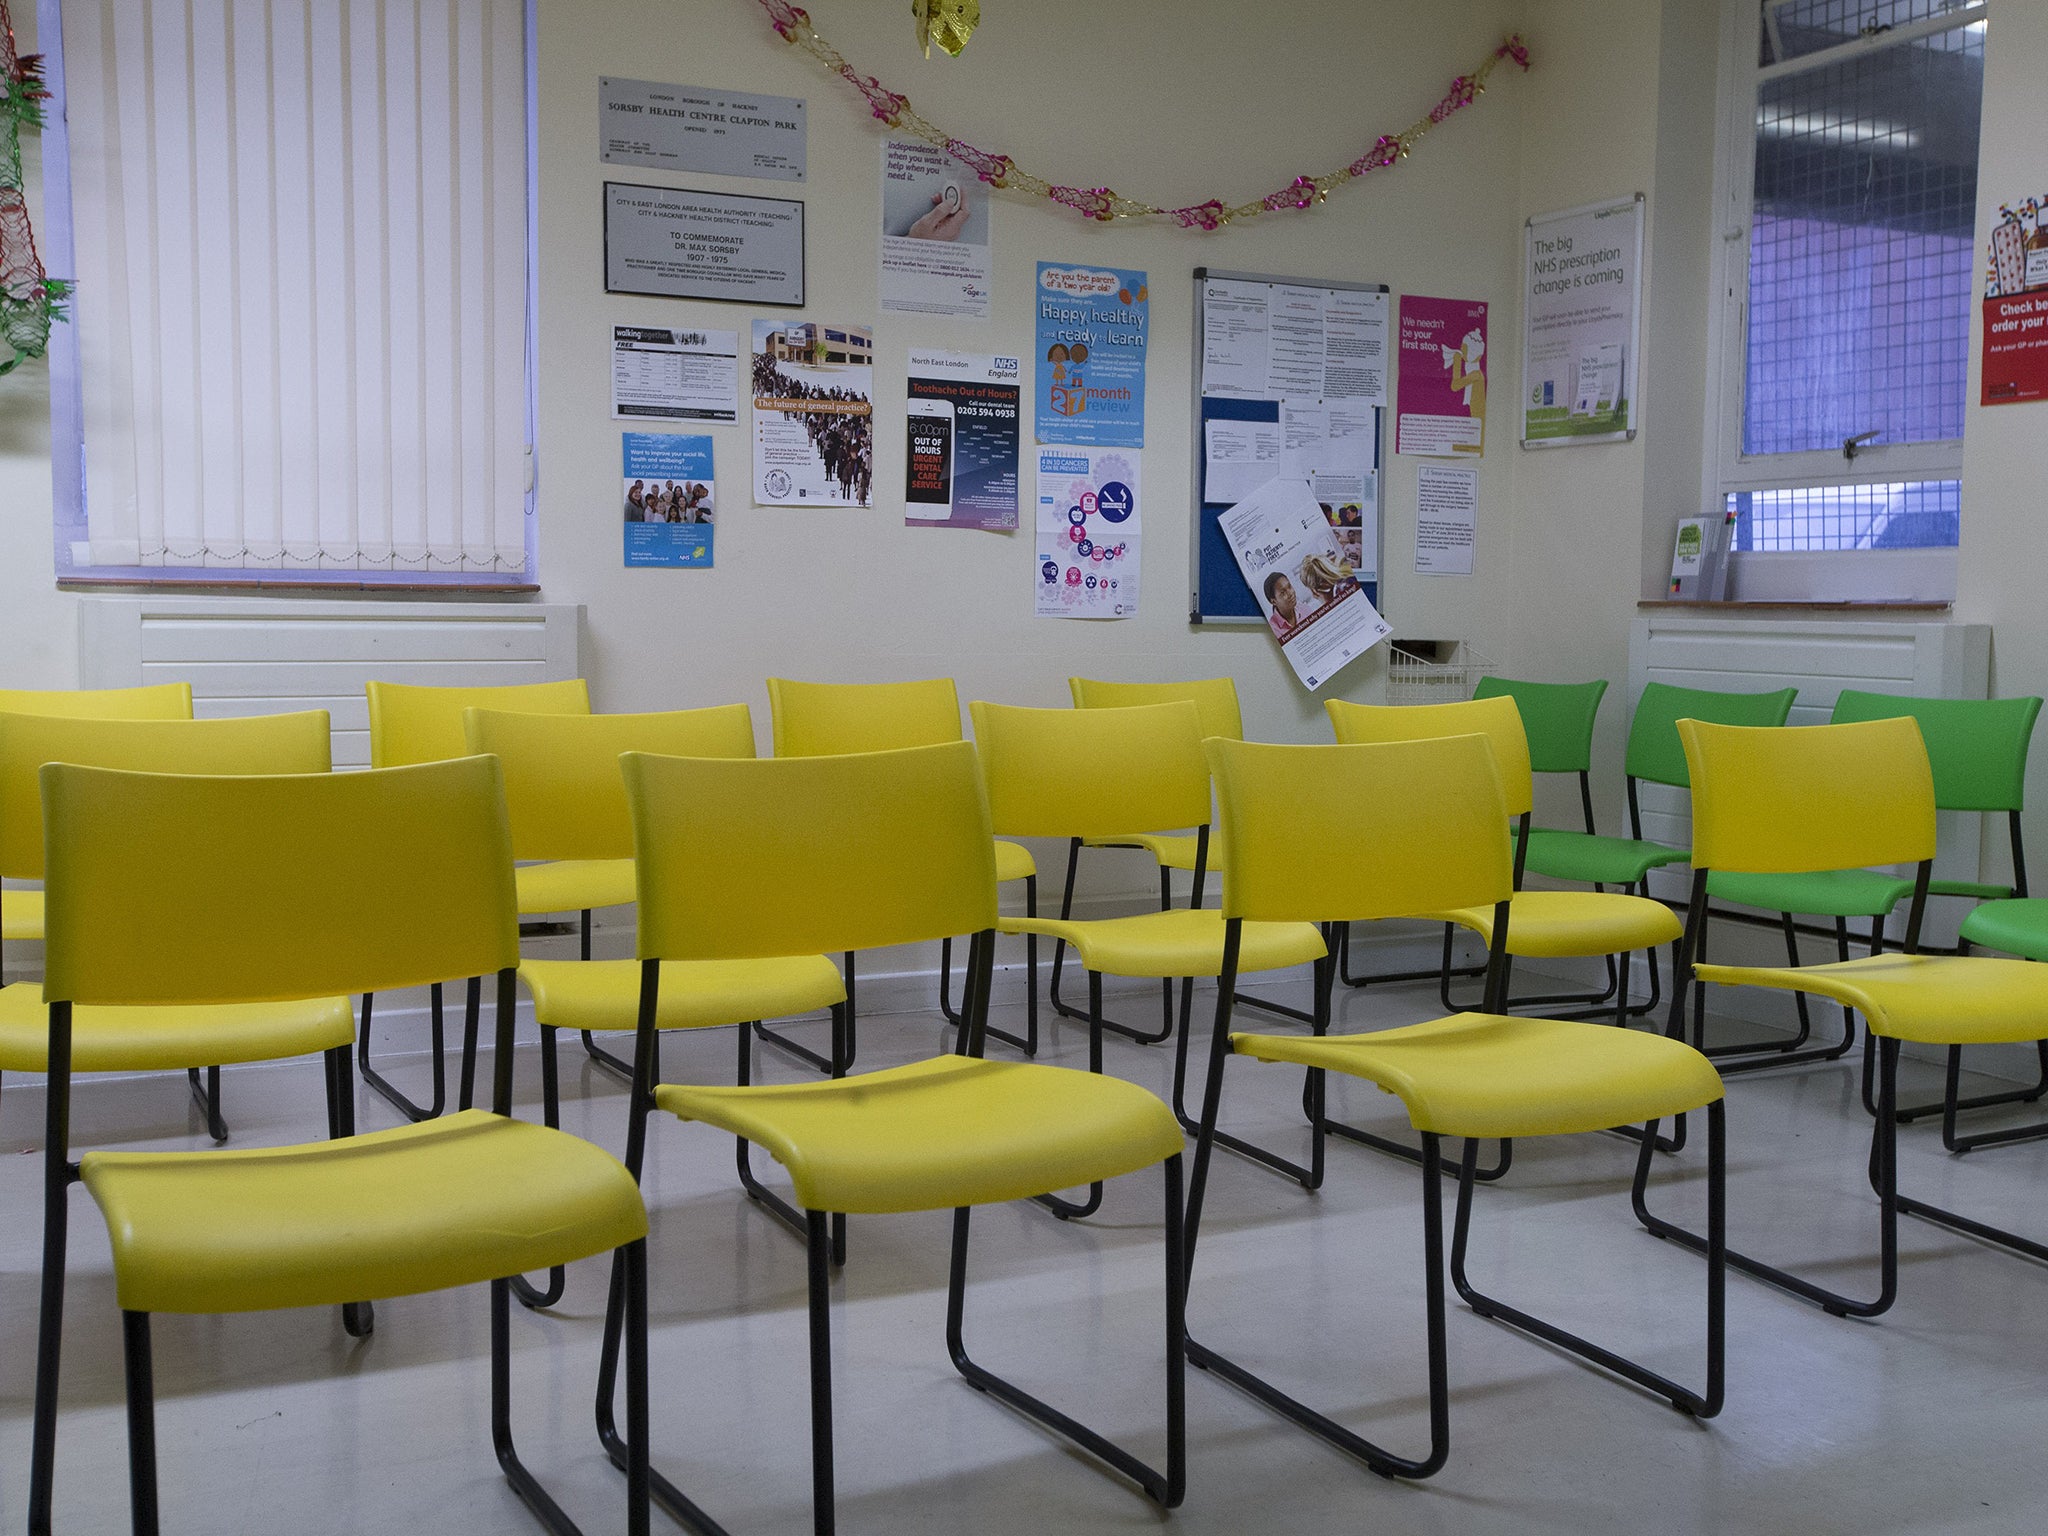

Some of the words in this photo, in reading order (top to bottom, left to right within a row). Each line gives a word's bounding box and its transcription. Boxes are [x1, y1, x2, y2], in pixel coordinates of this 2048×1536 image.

[649, 94, 674, 102] LONDON
[683, 98, 710, 106] BOROUGH
[732, 103, 758, 111] HACKNEY
[608, 101, 644, 114] SORSBY
[649, 106, 685, 118] HEALTH
[689, 111, 726, 123] CENTRE
[730, 116, 770, 127] CLAPTON
[774, 120, 797, 130] PARK
[888, 141, 939, 154] Independence
[888, 152, 908, 161] when
[908, 155, 923, 164] you
[923, 157, 942, 166] want
[942, 158, 952, 168] it,
[887, 160, 904, 171] help
[905, 164, 924, 173] when
[925, 166, 940, 175] you
[887, 172, 905, 181] need
[906, 174, 915, 182] it.
[616, 198, 631, 206] CITY
[637, 200, 653, 208] EAST
[654, 202, 681, 210] LONDON
[682, 205, 698, 213] AREA
[699, 206, 723, 214] HEALTH
[724, 208, 757, 217] AUTHORITY
[638, 209, 652, 217] CITY
[658, 212, 688, 220] HACKNEY
[689, 214, 713, 222] HEALTH
[713, 216, 740, 224] DISTRICT
[670, 231, 681, 239] TO
[682, 232, 744, 245] COMMEMORATE
[674, 242, 688, 250] DR.
[689, 244, 707, 252] MAX
[708, 245, 740, 255] SORSBY
[1534, 240, 1555, 256] The
[1556, 236, 1573, 253] big
[687, 253, 705, 262] 1907
[711, 255, 729, 264] 1975
[1534, 257, 1556, 275] NHS
[1558, 247, 1621, 274] prescription
[1047, 271, 1059, 280] Are
[1061, 273, 1075, 282] you
[1077, 273, 1090, 282] the
[1091, 276, 1115, 286] parent
[1533, 278, 1572, 296] change
[1573, 274, 1582, 288] is
[1584, 268, 1624, 286] coming
[1046, 279, 1056, 287] of
[1064, 281, 1077, 290] two
[1078, 284, 1096, 293] year
[1097, 284, 1112, 292] old?
[1071, 298, 1083, 306] they
[2000, 300, 2033, 317] Check
[1041, 303, 1088, 327] Happy,
[1091, 308, 1145, 332] healthy
[1402, 316, 1415, 327] We
[1416, 318, 1445, 329] needn't
[1991, 320, 2019, 334] order
[2020, 316, 2045, 333] your
[1056, 329, 1098, 349] ready
[1107, 330, 1144, 348] learn
[1402, 328, 1413, 338] be
[1414, 331, 1432, 342] your
[1402, 340, 1419, 350] first
[1419, 342, 1440, 353] stop.
[1990, 345, 2002, 353] Ask
[2002, 344, 2016, 353] your
[2017, 341, 2027, 349] GP
[911, 357, 930, 365] North
[945, 360, 969, 368] London
[995, 358, 1017, 369] NHS
[987, 369, 1018, 379] England
[913, 383, 958, 396] Toothache
[959, 386, 975, 397] Out
[976, 388, 986, 397] of
[987, 388, 1017, 400] Hours?
[1086, 387, 1131, 401] month
[757, 399, 772, 407] The
[774, 400, 797, 409] future
[797, 401, 805, 409] of
[806, 401, 834, 411] general
[836, 403, 868, 413] practice?
[1052, 388, 1084, 414] 27
[1086, 400, 1130, 413] review
[957, 406, 977, 415] 0203
[978, 407, 993, 417] 594
[995, 408, 1016, 418] 0938
[909, 422, 949, 437] 6:00pm
[914, 437, 930, 446] OUT
[931, 438, 943, 446] OF
[915, 446, 942, 455] HOURS
[913, 454, 943, 463] URGENT
[913, 463, 942, 472] DENTAL
[917, 473, 938, 481] CARE
[912, 480, 943, 489] SERVICE
[1263, 544, 1272, 553] PUT
[1265, 542, 1284, 558] PATIENTS
[1267, 551, 1280, 562] FIRST
